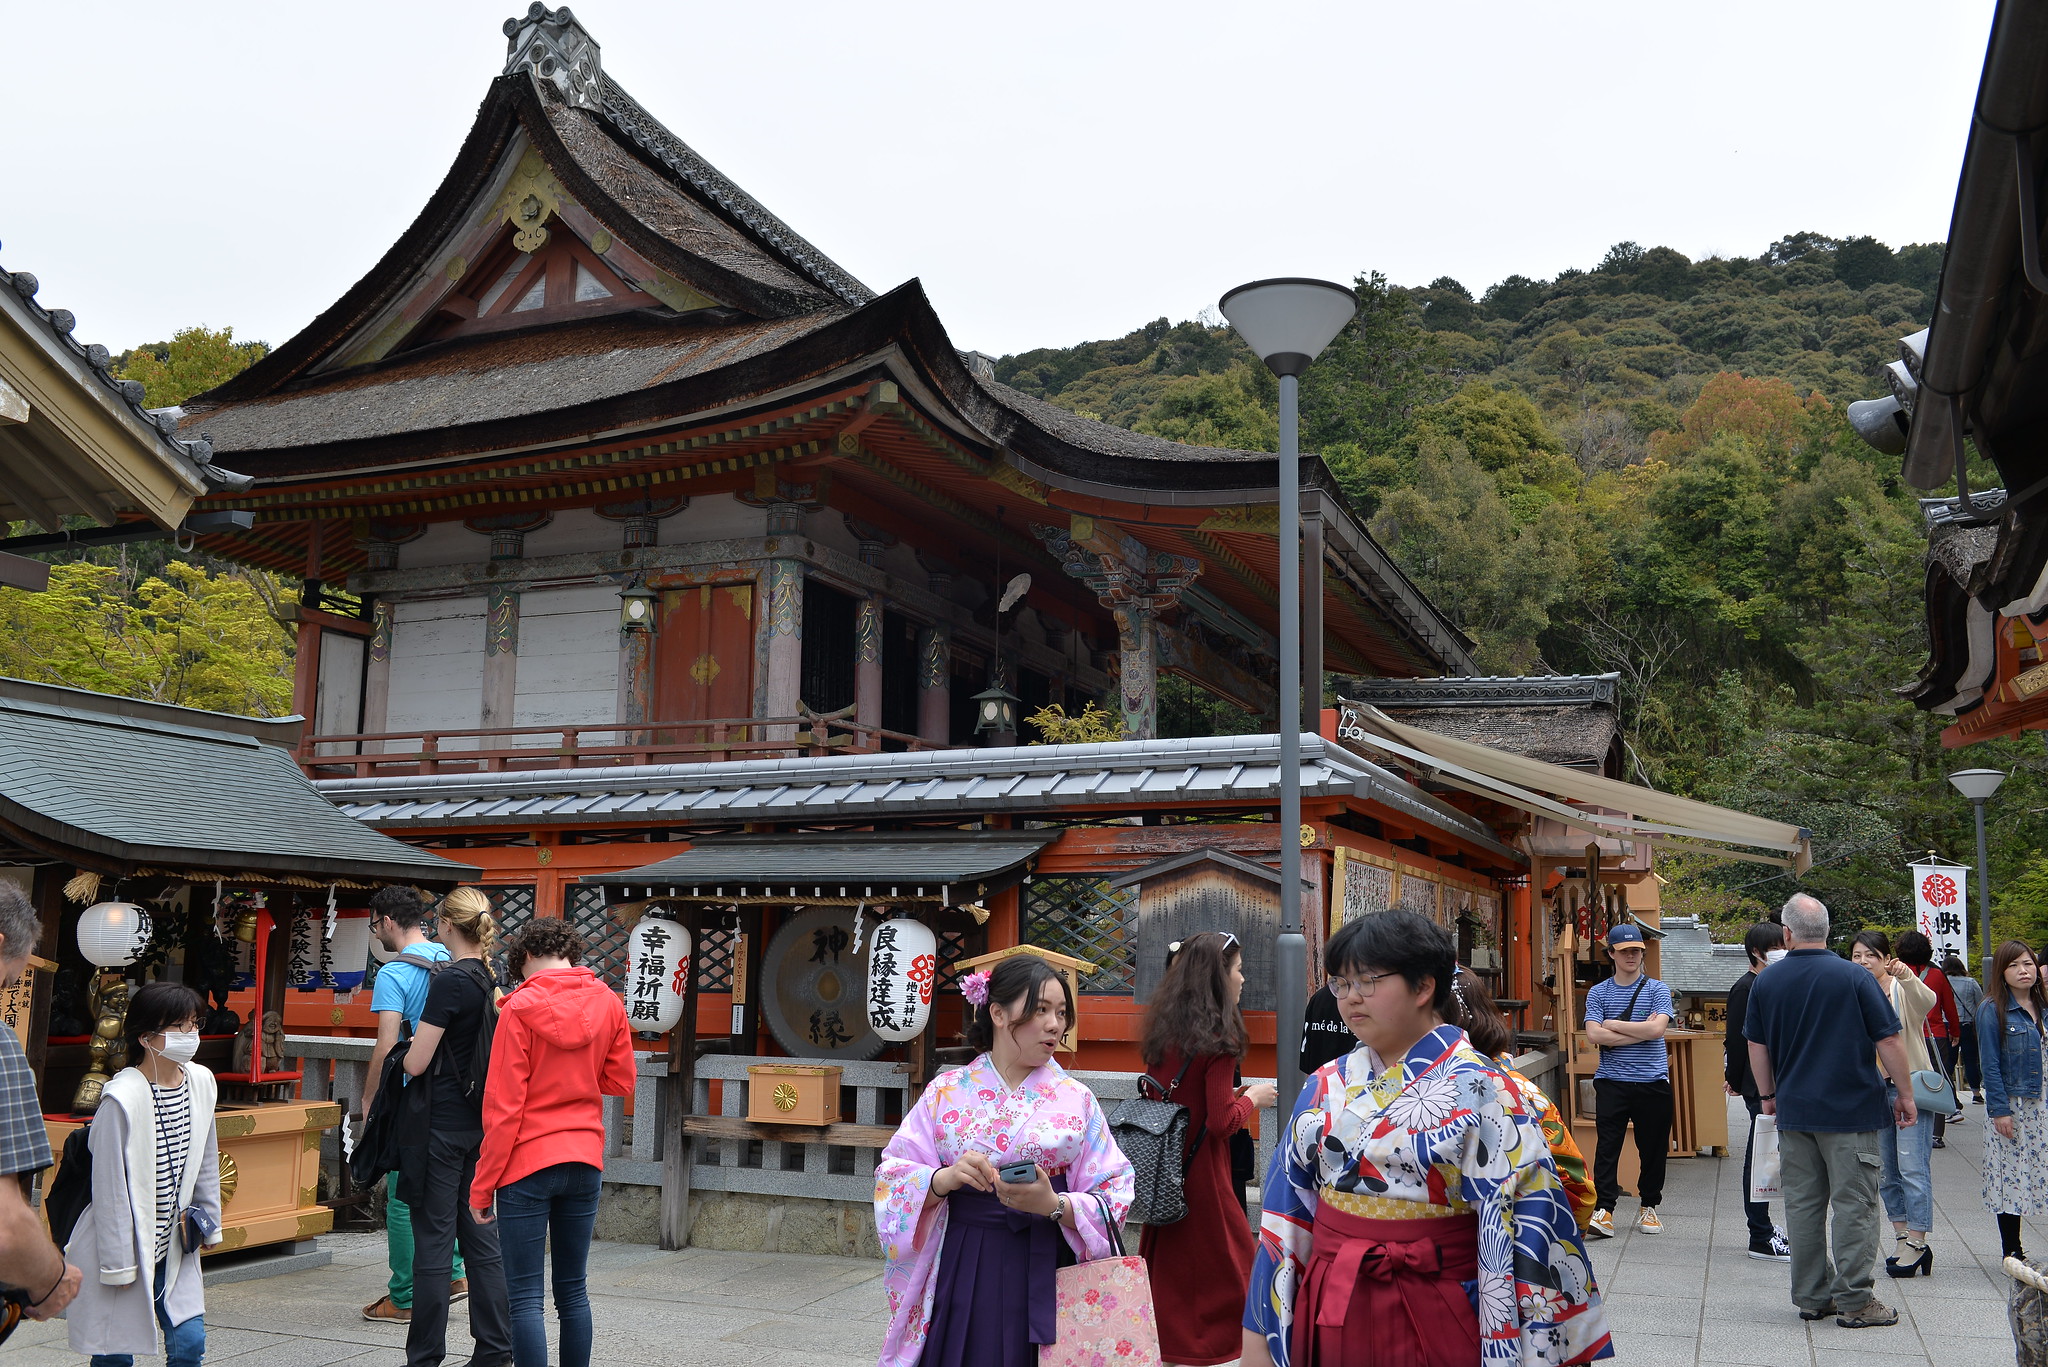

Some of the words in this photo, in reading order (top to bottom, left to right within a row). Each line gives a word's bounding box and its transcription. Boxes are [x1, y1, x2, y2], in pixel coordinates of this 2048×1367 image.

[630, 925, 672, 1021] 幸福祈願
[869, 925, 902, 1032] 良縁達成
[902, 981, 918, 1028] 地主神社
[1311, 1019, 1326, 1031] mé
[1326, 1020, 1338, 1033] de
[1339, 1021, 1349, 1034] la
